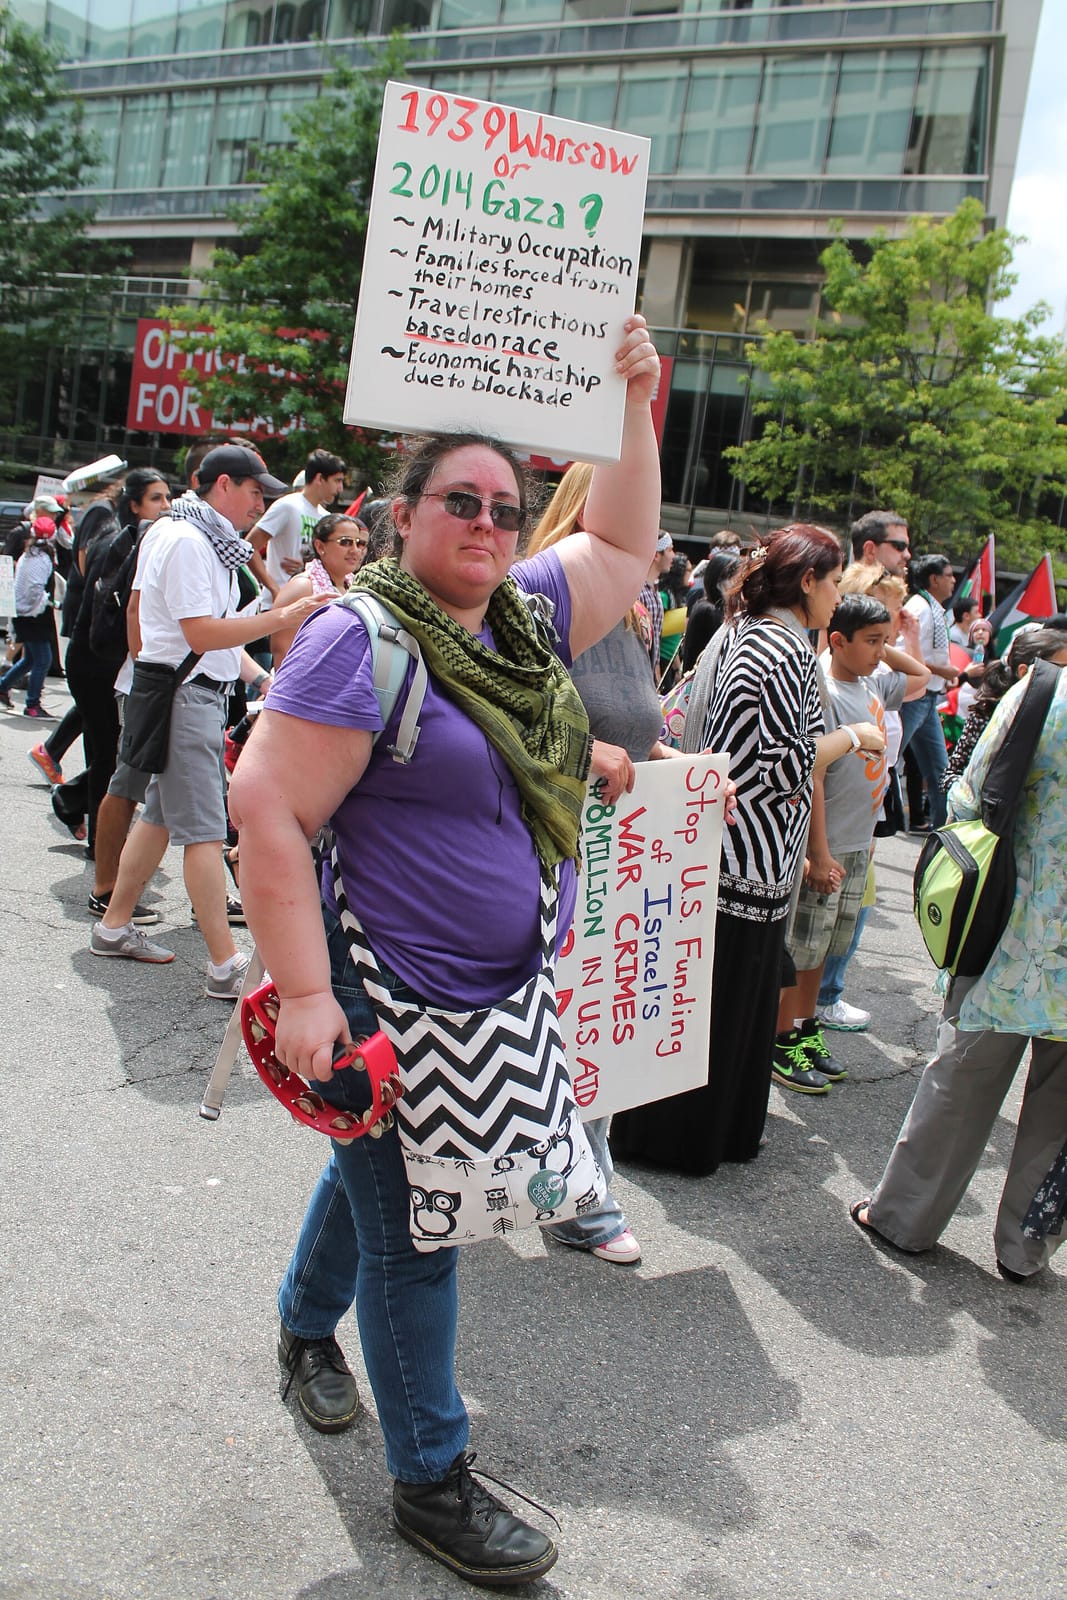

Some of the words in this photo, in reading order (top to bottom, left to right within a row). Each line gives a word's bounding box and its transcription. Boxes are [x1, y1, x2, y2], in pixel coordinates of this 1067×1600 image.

[389, 161, 474, 210] 2014
[415, 245, 499, 275] Families
[502, 258, 563, 287] forced
[570, 270, 620, 296] from
[421, 216, 512, 255] Military
[517, 232, 633, 277] Occupation
[414, 268, 465, 290] their
[469, 274, 534, 300] homes
[406, 286, 479, 321] Travel
[483, 304, 609, 339] restrictions
[405, 317, 472, 344] based
[474, 332, 498, 349] on
[501, 335, 561, 362] race
[404, 365, 444, 387] due
[448, 372, 466, 389] to
[472, 375, 573, 408] blockade
[406, 341, 501, 376] Economic
[506, 356, 601, 393] hardship
[135, 383, 202, 428] FOR
[674, 766, 722, 844] Stop
[615, 806, 648, 892] WAR
[651, 839, 673, 863] of
[680, 864, 709, 924] U.S.
[581, 956, 604, 988] IN
[642, 883, 672, 1020] Israel's
[612, 912, 641, 1045] CRIMES
[655, 937, 703, 1057] Funding
[574, 999, 602, 1050] U.S.
[572, 1056, 601, 1107] AID
